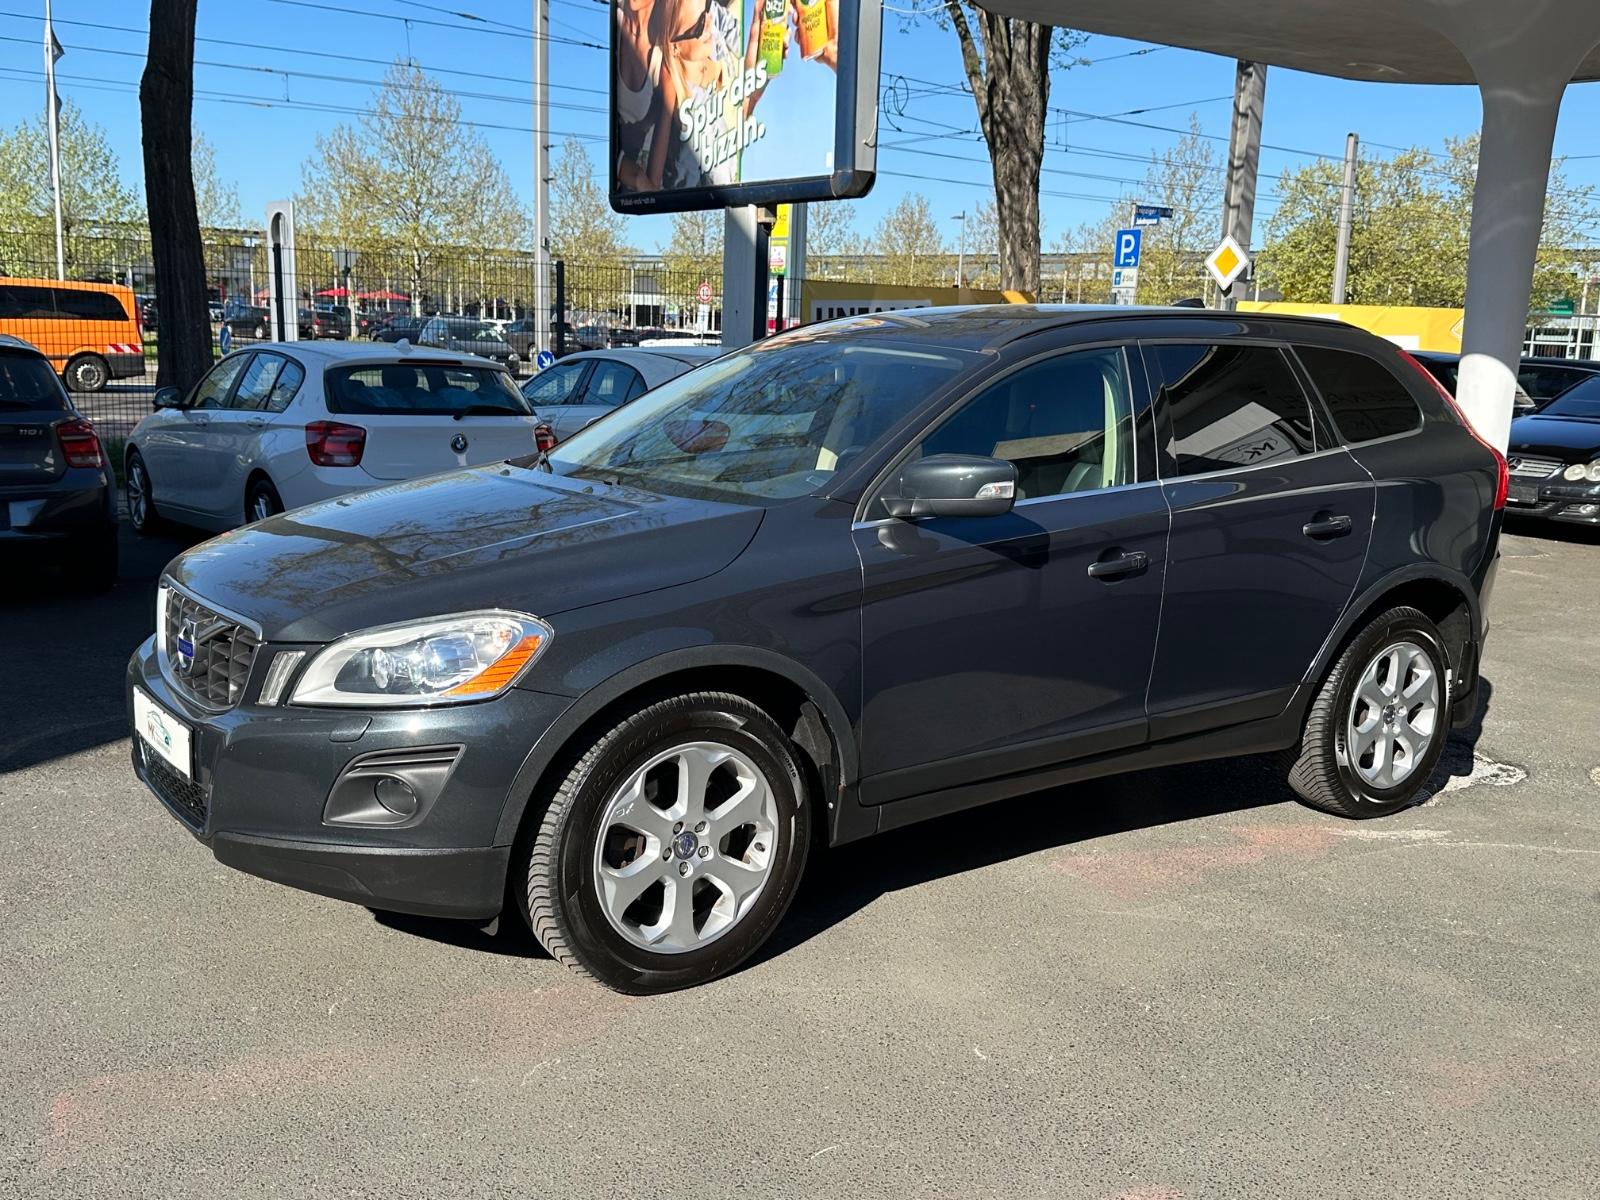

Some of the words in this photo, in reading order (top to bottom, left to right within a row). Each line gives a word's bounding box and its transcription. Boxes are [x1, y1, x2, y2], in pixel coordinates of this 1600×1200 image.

[679, 80, 728, 152] Spür
[731, 57, 768, 105] das
[1120, 234, 1136, 265] P
[701, 288, 709, 297] 10
